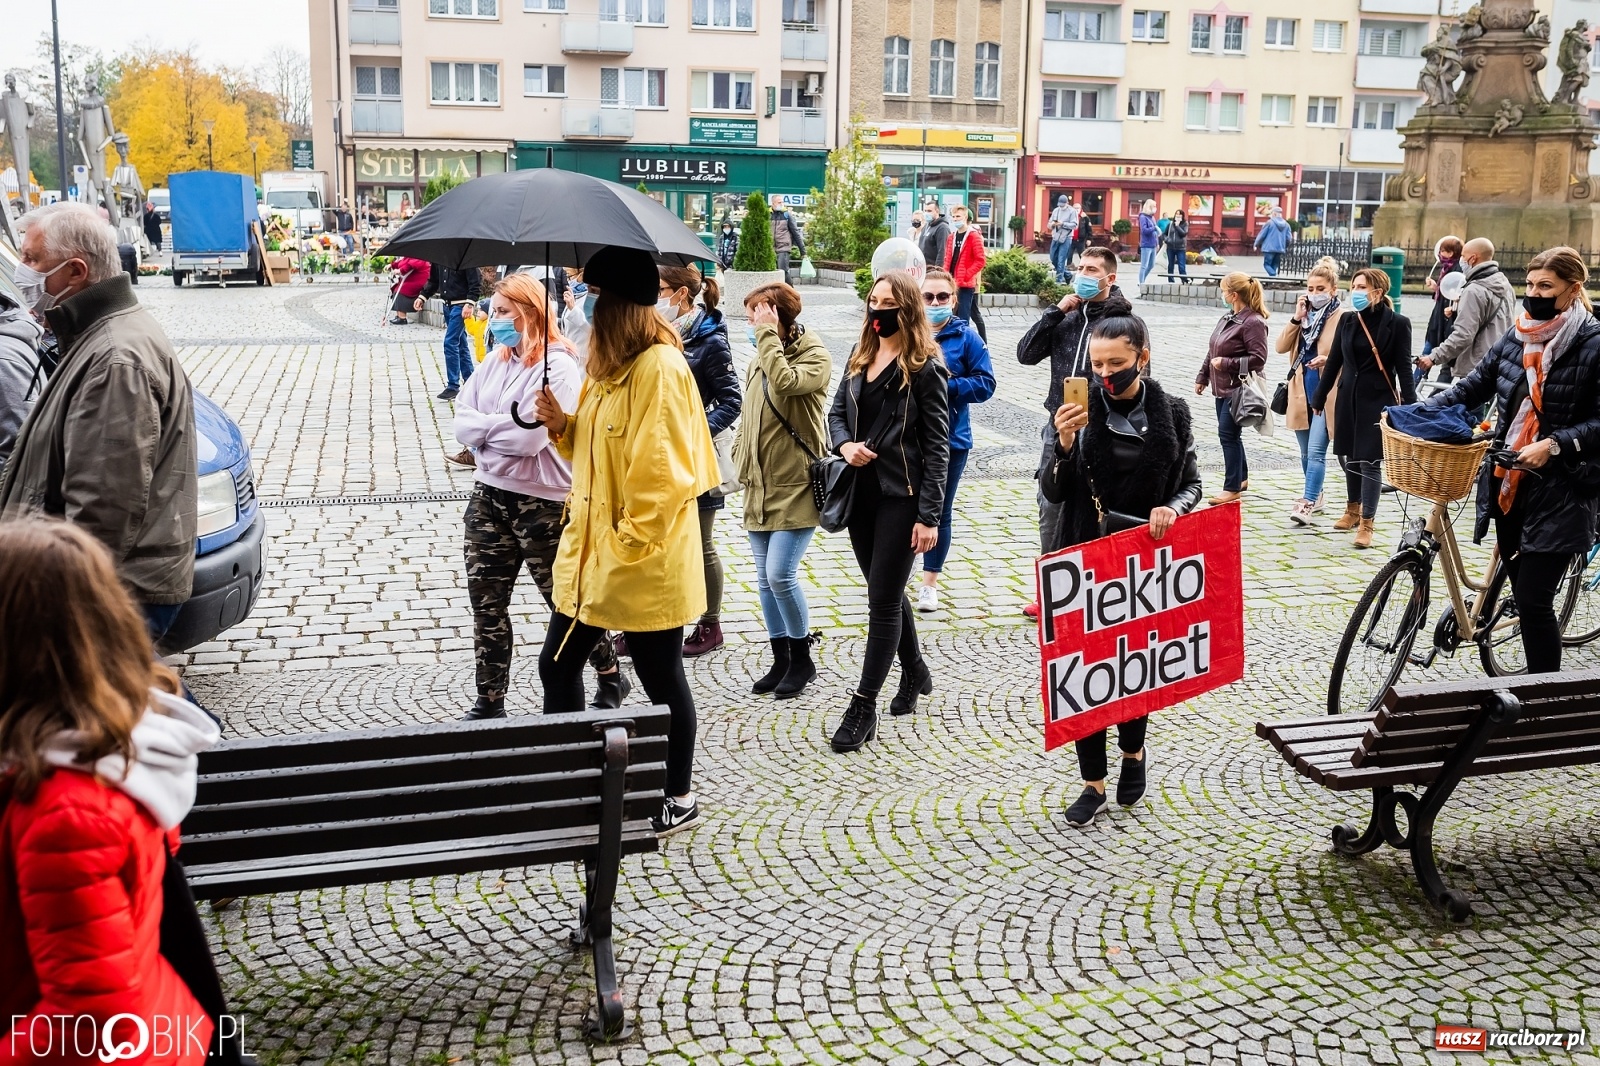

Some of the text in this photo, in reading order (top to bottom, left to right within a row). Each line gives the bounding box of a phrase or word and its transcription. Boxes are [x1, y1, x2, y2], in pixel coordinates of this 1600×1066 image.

[360, 150, 471, 178] STELLA
[622, 159, 726, 174] JUBILER
[1125, 166, 1211, 177] RESTAURACJA
[1042, 548, 1204, 642] Piekło
[1050, 625, 1208, 720] Kobiet
